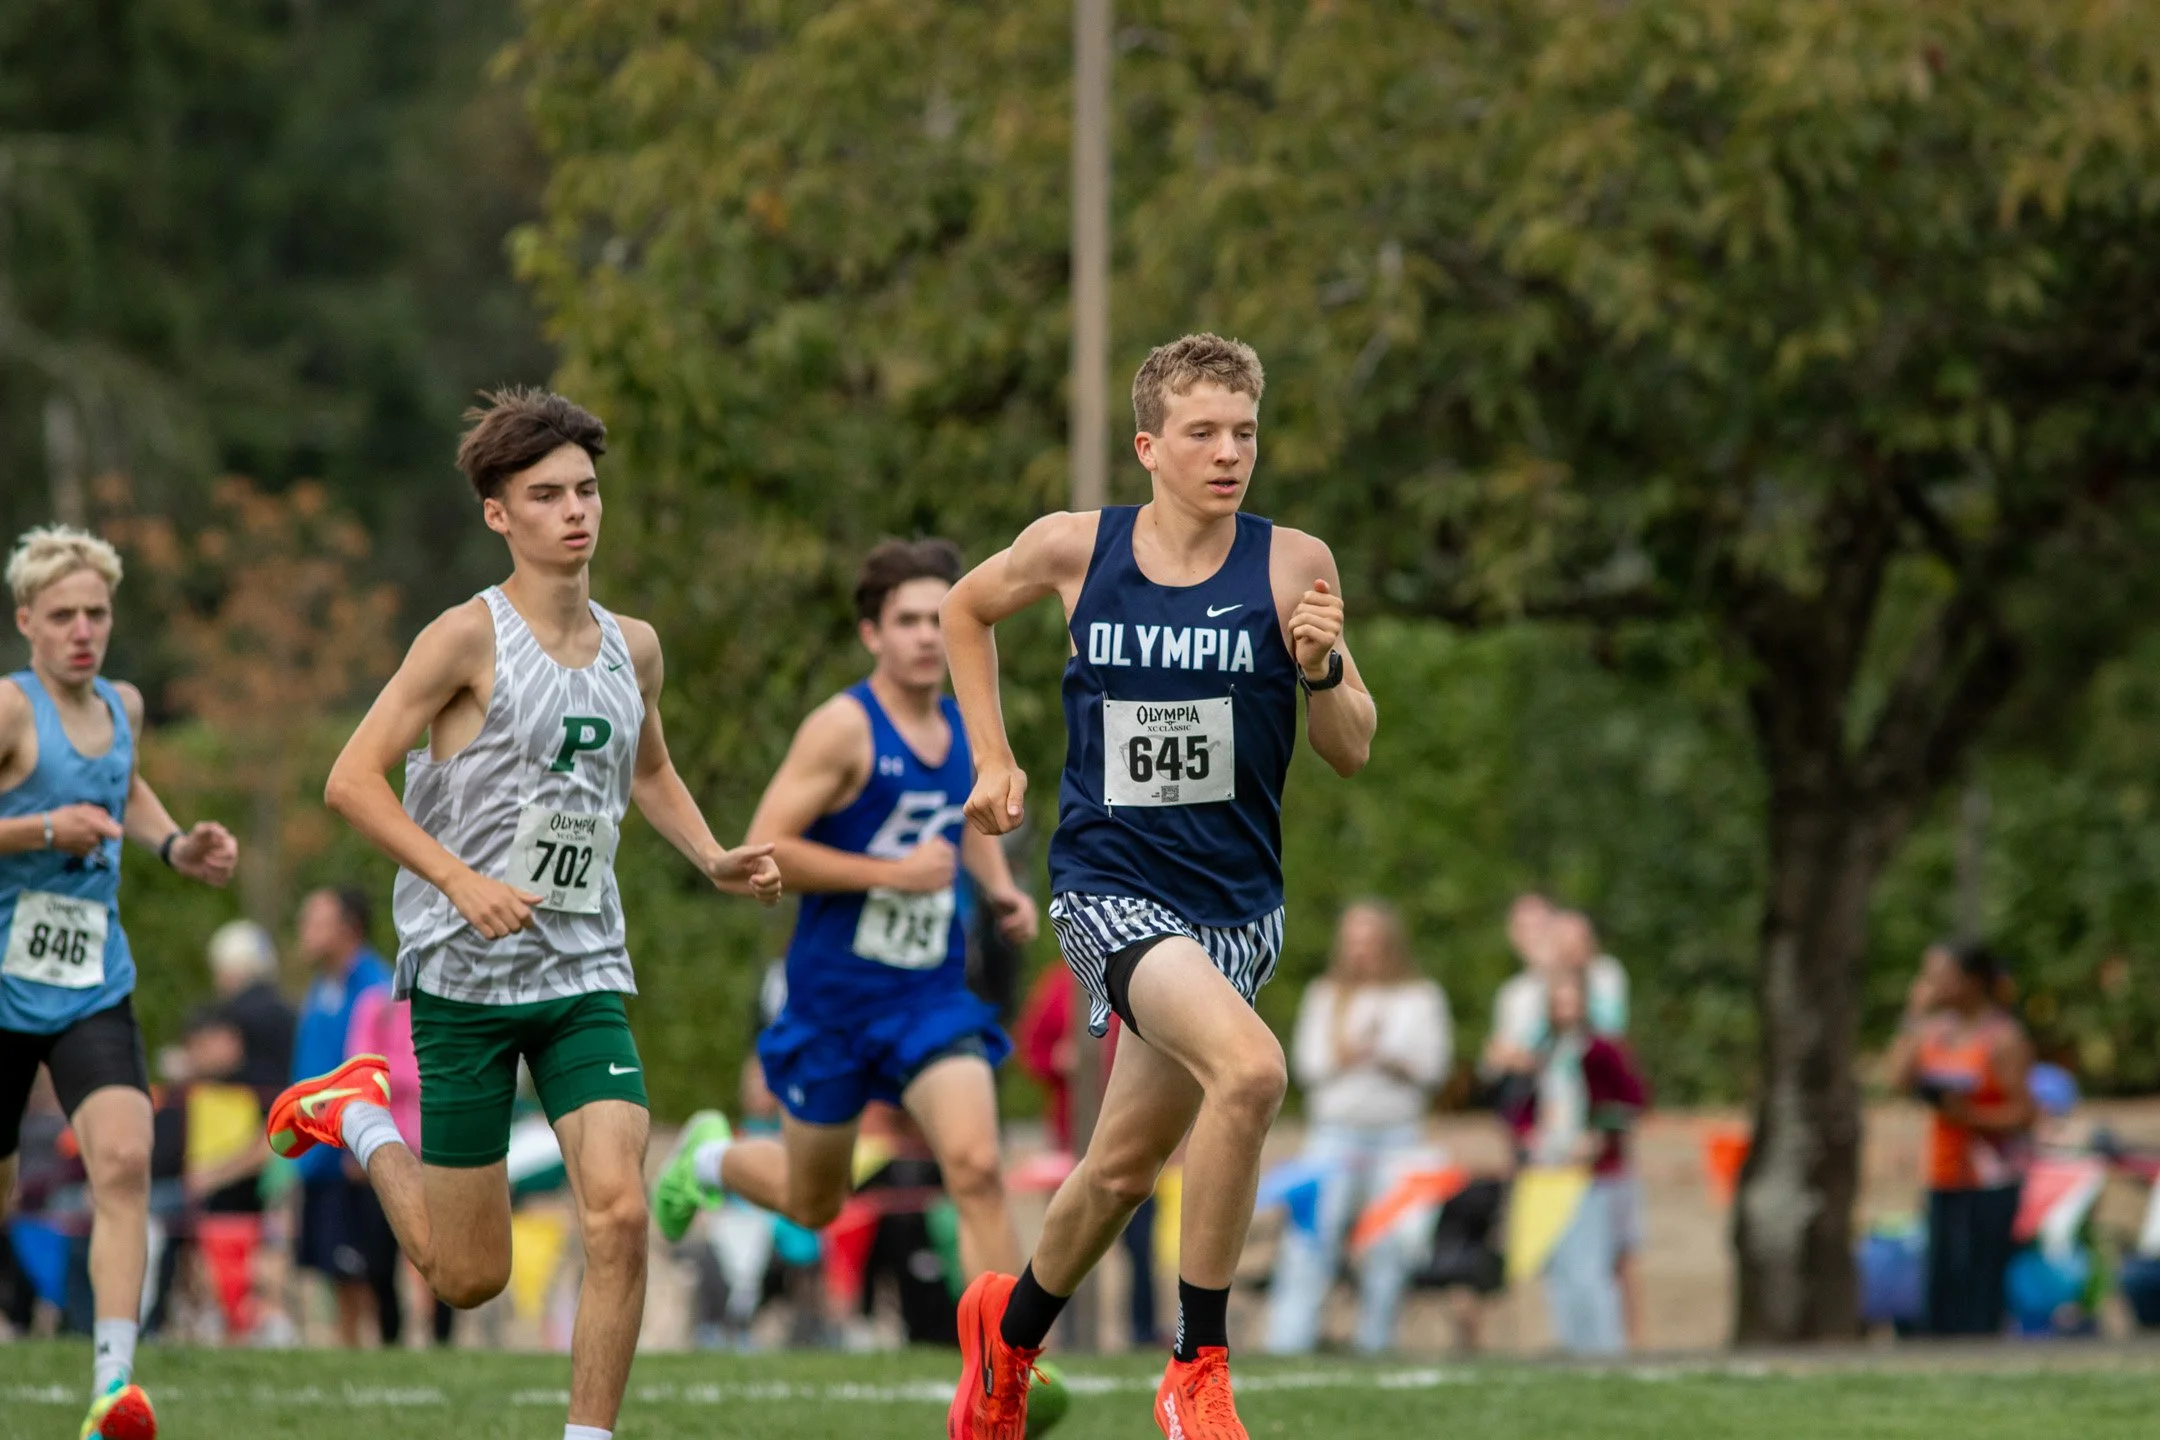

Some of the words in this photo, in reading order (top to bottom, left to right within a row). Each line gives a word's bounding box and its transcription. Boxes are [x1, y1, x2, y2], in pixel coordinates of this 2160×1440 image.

[1088, 622, 1254, 673] OLYMPIA
[1136, 705, 1201, 726] OLYMPIA
[1159, 724, 1192, 732] CLASSIC
[550, 716, 612, 773] P
[1129, 735, 1210, 782] 645
[550, 812, 597, 836] OLYMPIA
[530, 840, 593, 888] 702
[29, 922, 89, 965] 846
